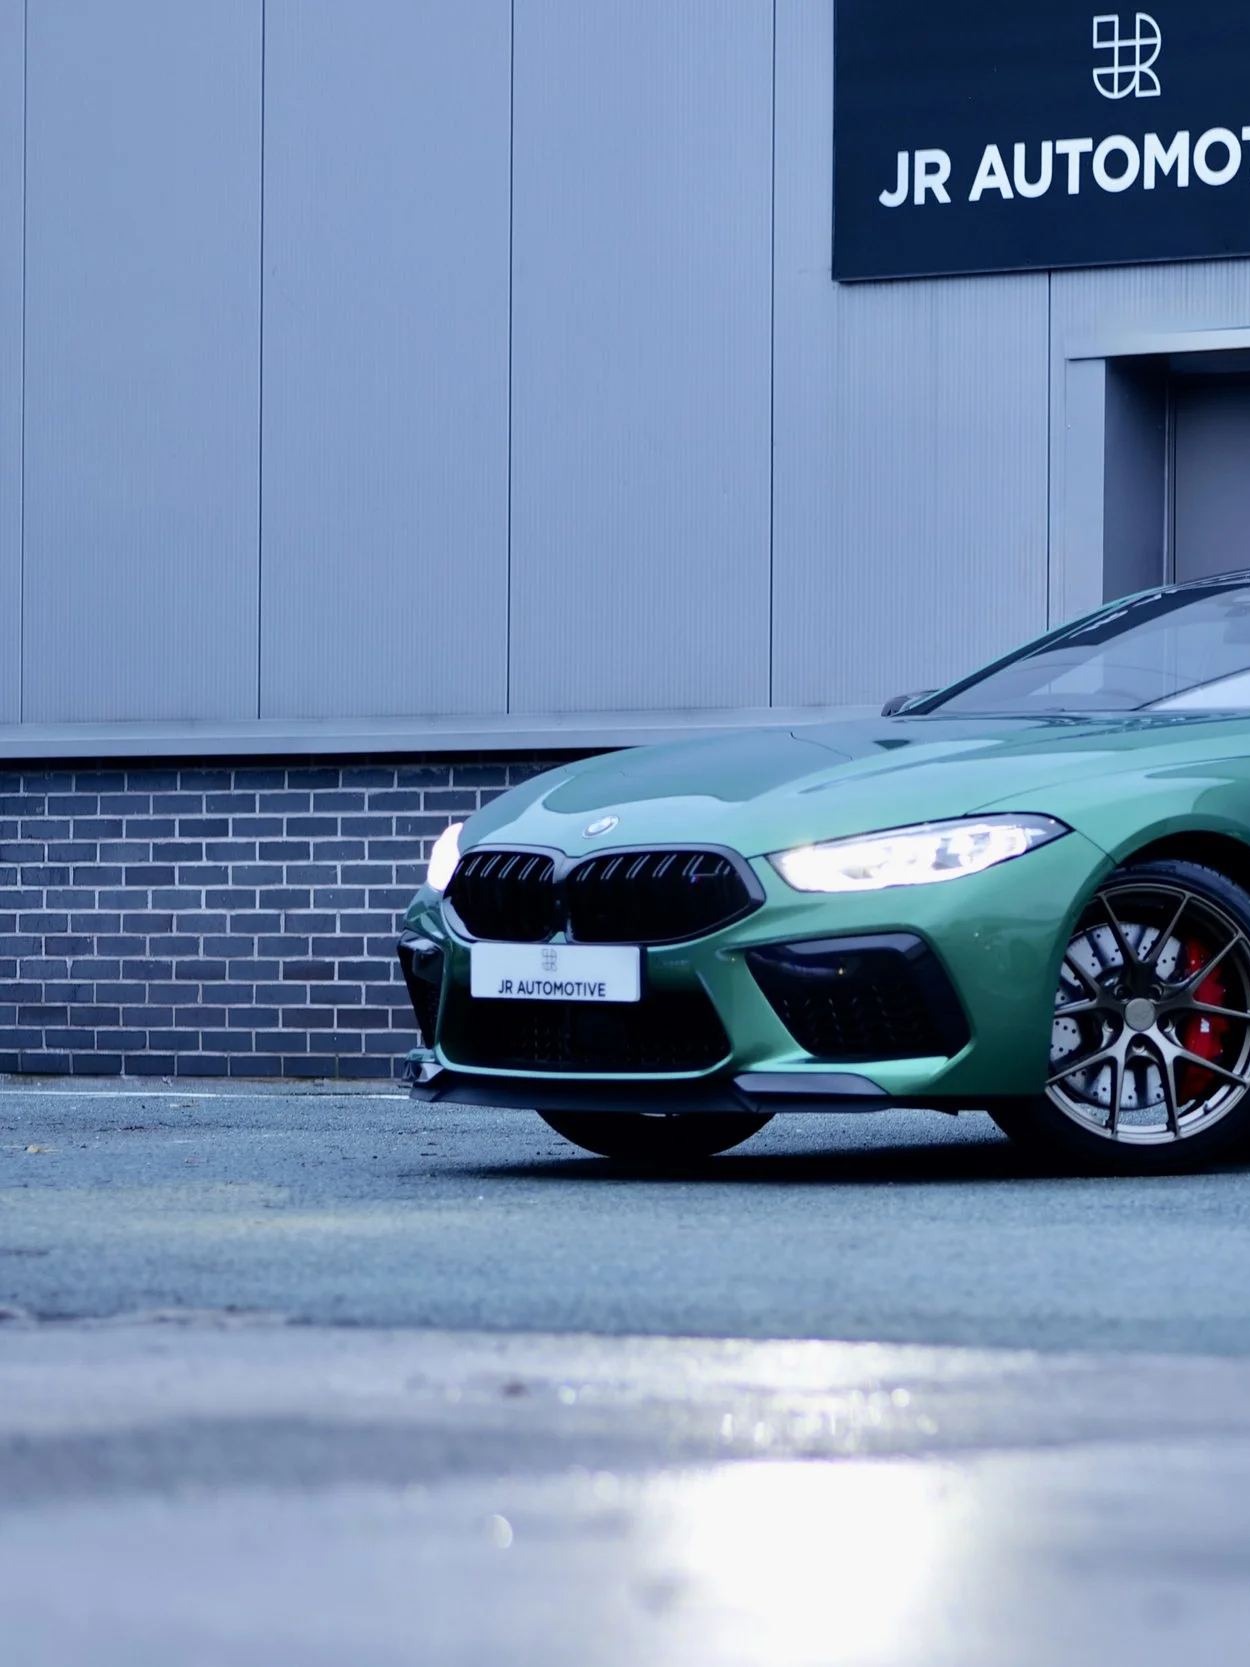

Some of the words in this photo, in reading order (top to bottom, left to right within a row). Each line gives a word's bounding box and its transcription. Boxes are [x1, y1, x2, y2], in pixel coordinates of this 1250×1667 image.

[879, 148, 952, 208] JR
[498, 979, 513, 994] JR
[516, 980, 606, 997] AUTOMOTIVE
